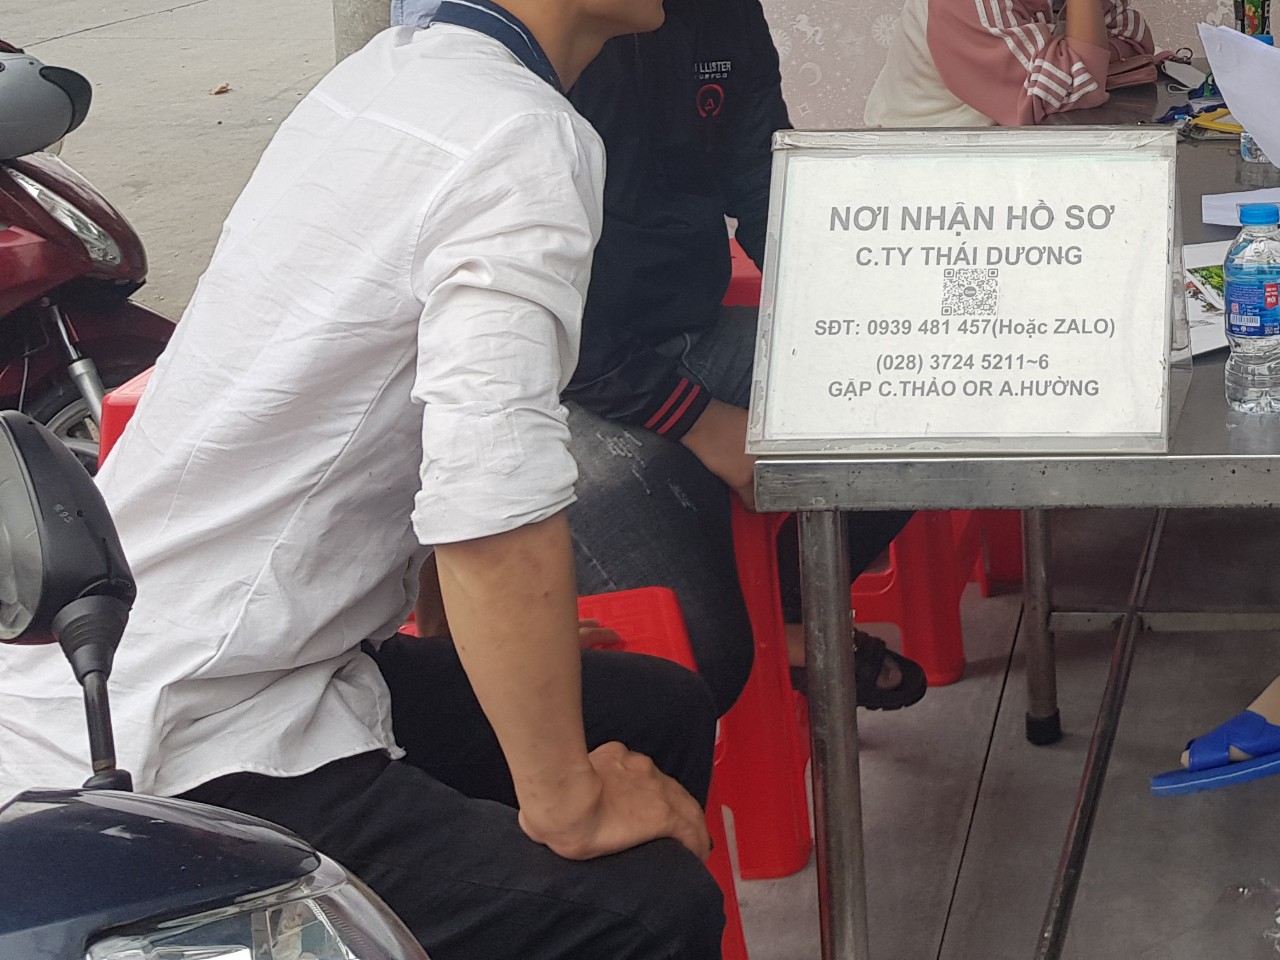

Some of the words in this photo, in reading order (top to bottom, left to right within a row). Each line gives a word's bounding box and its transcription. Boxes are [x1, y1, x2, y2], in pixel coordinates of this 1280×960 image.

[830, 206, 889, 231] NƠI
[901, 202, 994, 236] NHẬN
[1007, 200, 1054, 230] HỒ
[1065, 205, 1115, 229] SƠ
[857, 247, 912, 266] C.TY
[921, 242, 977, 265] THÁI
[987, 246, 1081, 265] DƯƠNG
[815, 320, 859, 335] SĐT:
[868, 320, 911, 335] 0939
[918, 320, 949, 334] 481
[958, 319, 1047, 338] 457(Hoặc
[1054, 319, 1114, 338] ZALO)
[877, 354, 923, 374] (028)
[930, 354, 974, 369] 3724
[982, 354, 1048, 369] 5211~6
[829, 379, 871, 400] GẶP
[879, 377, 956, 396] C.THẢO
[963, 381, 992, 396] OR
[999, 376, 1098, 396] A.HƯỜNG
